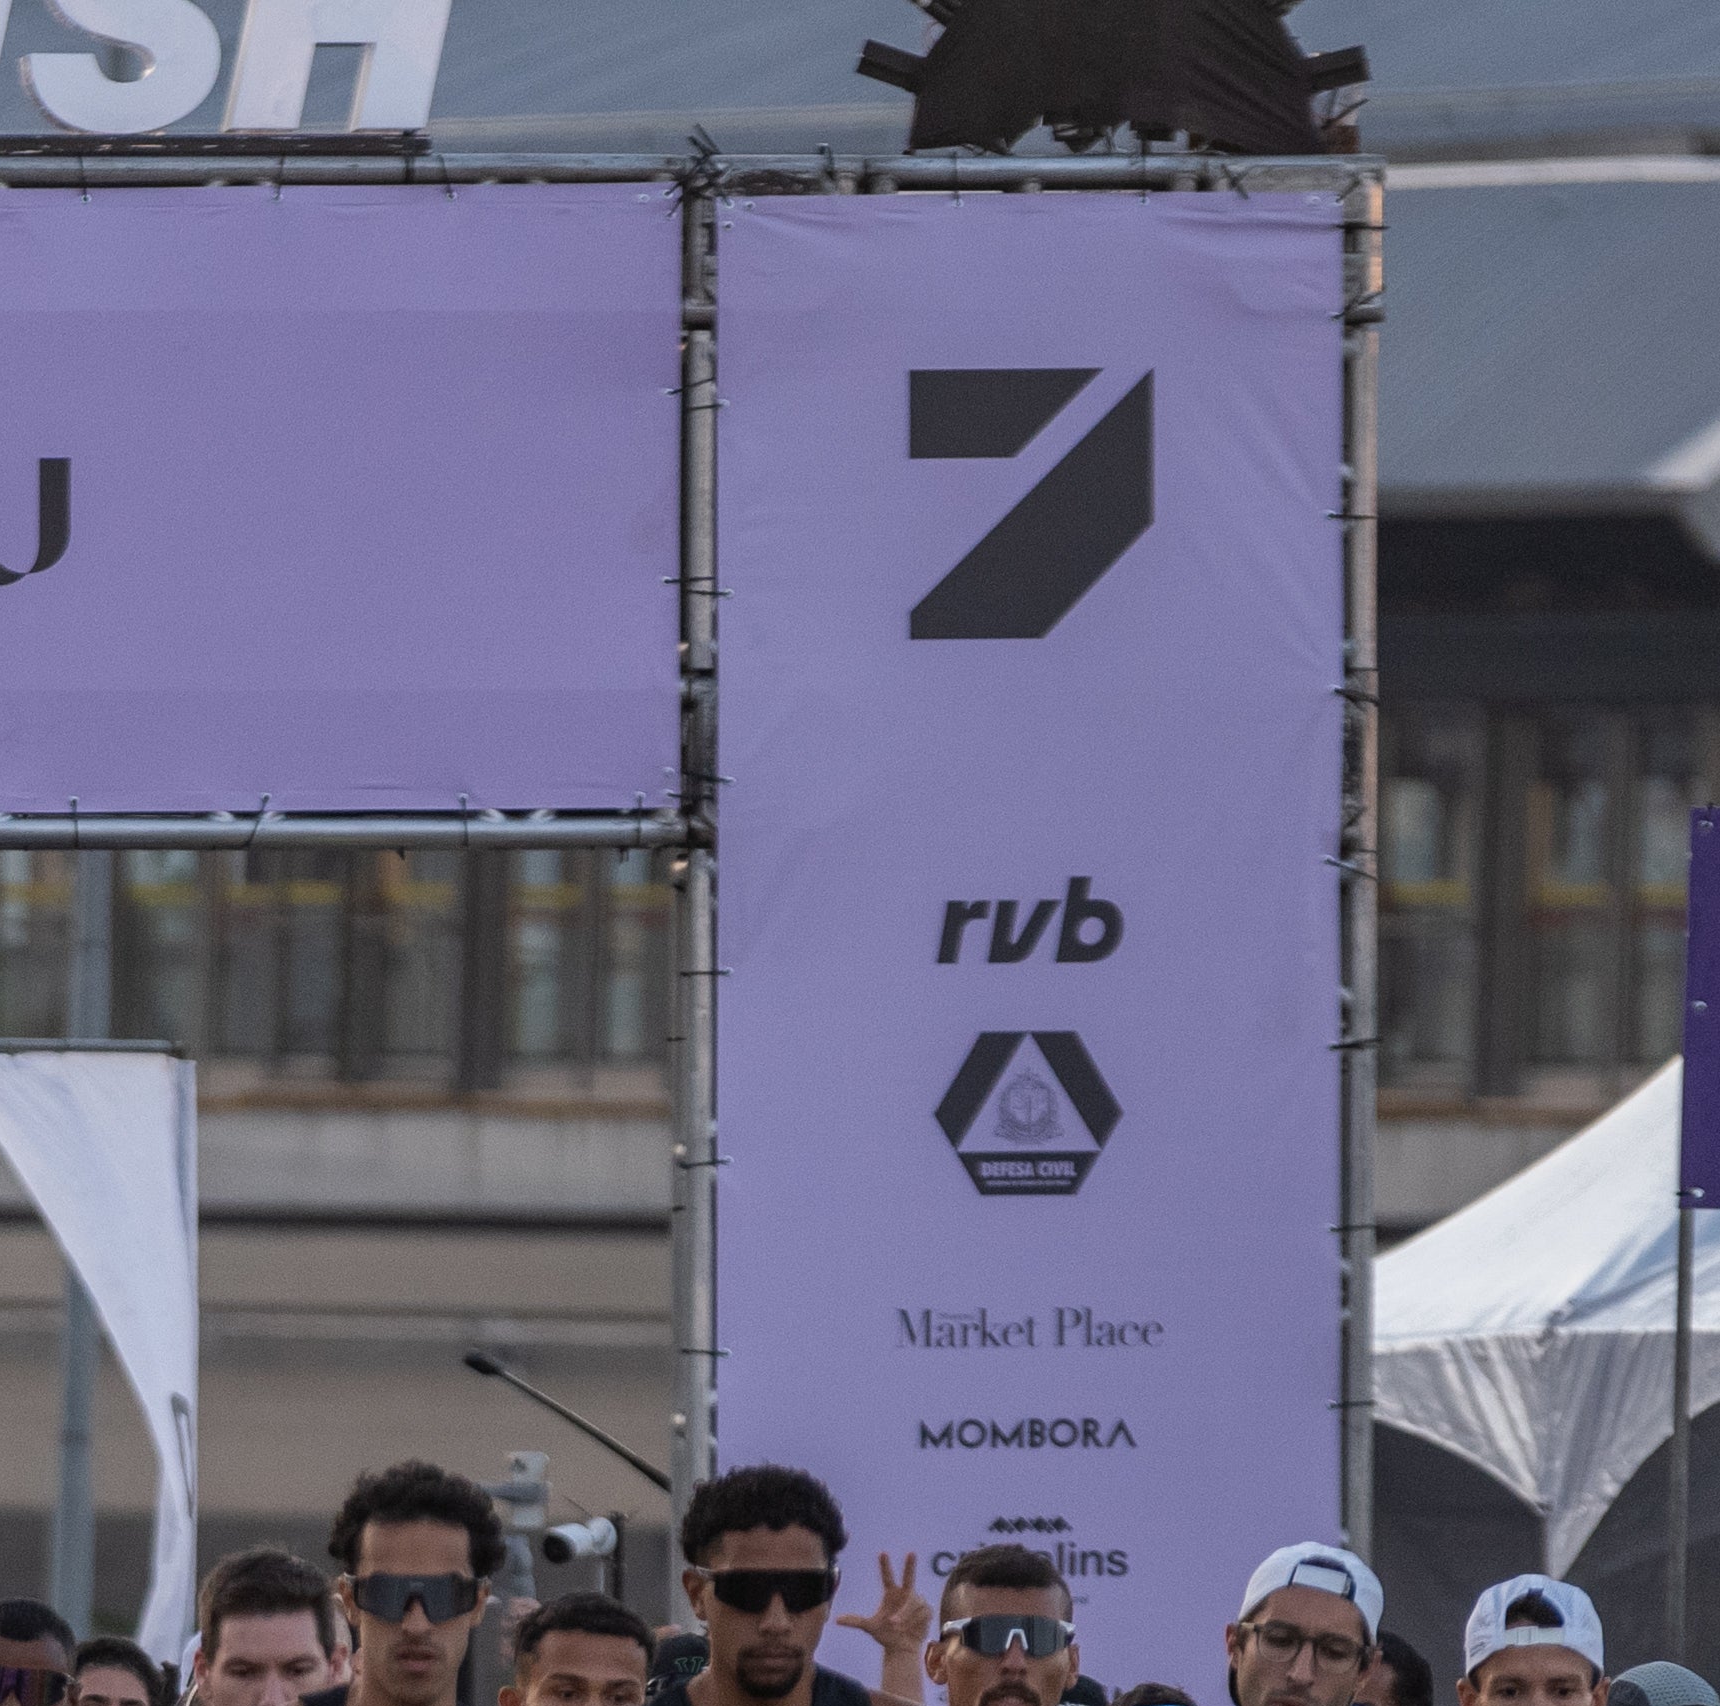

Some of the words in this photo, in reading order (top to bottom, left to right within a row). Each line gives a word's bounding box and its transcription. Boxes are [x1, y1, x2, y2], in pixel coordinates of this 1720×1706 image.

[935, 875, 1126, 964] rvb
[980, 1161, 1035, 1177] DEFESA
[1037, 1161, 1076, 1177] CIVIL
[896, 1306, 1038, 1349] Market
[1054, 1306, 1164, 1347] Place
[918, 1417, 1137, 1449] MOMBORA
